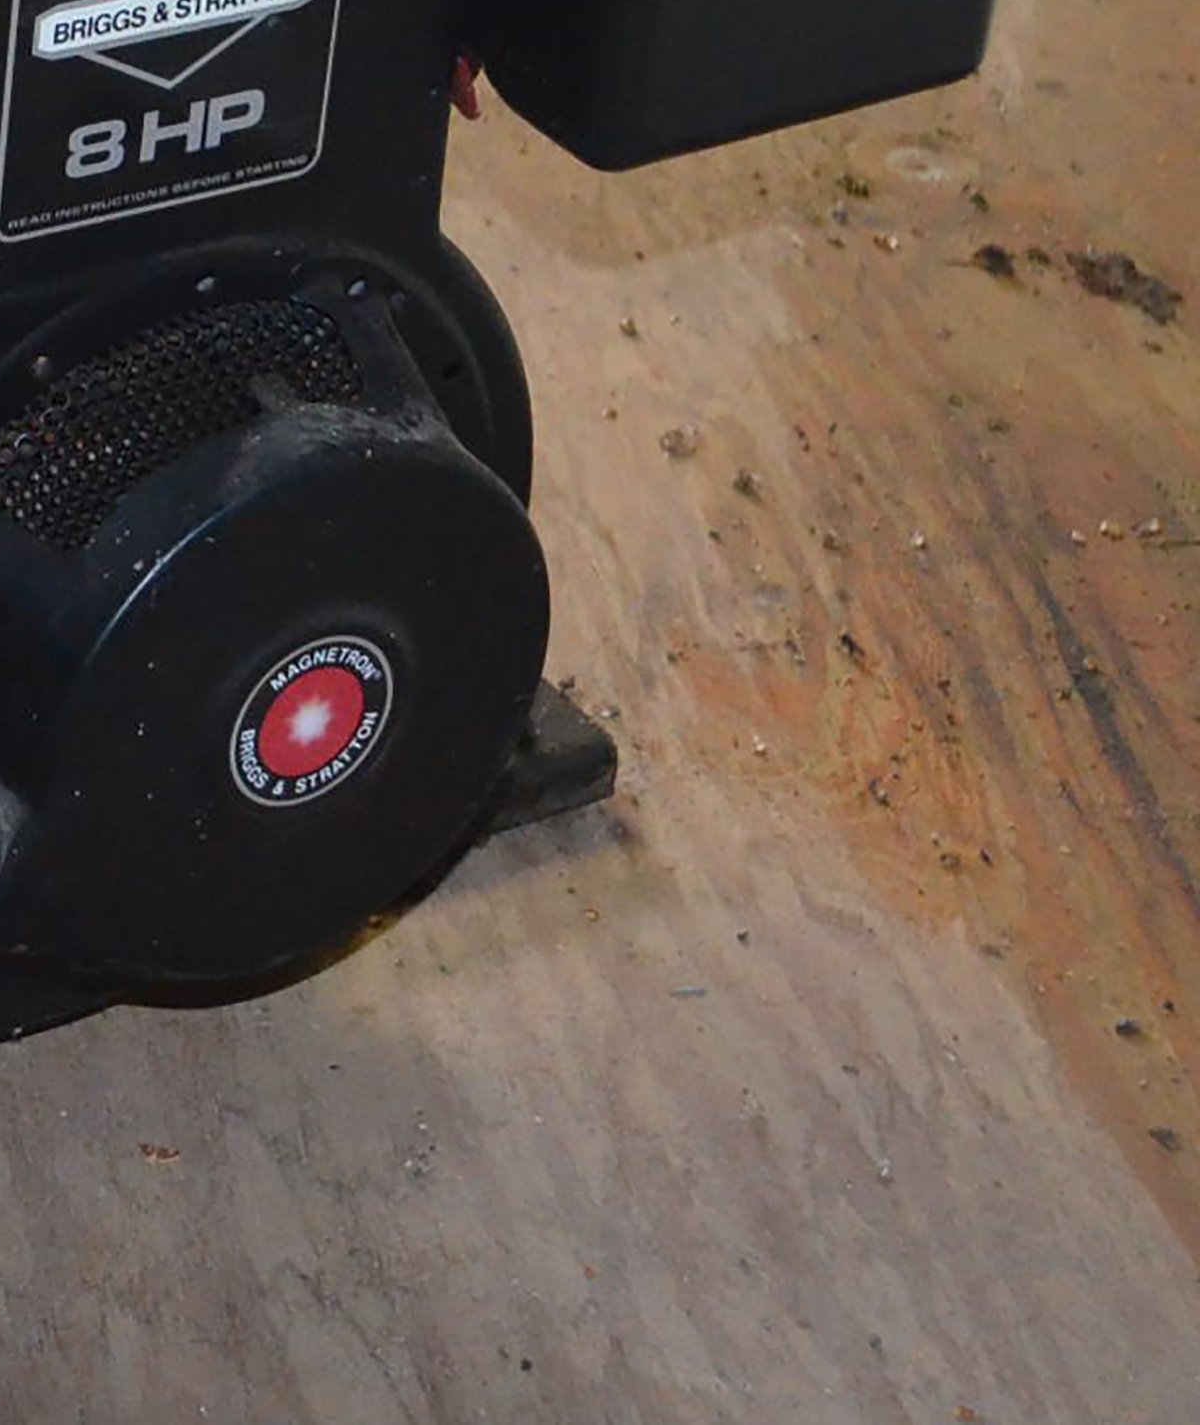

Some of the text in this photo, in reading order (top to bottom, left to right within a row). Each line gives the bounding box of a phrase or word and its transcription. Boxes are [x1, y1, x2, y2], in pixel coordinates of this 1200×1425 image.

[53, 8, 146, 44] BRIGGS
[153, 3, 168, 22] &
[65, 89, 265, 178] 8 HP
[55, 186, 169, 218] INSTRUCTIONS
[172, 171, 231, 193] BEFORE
[235, 155, 308, 178] STARTING
[270, 646, 377, 691] MAGNETRON
[240, 711, 378, 795] BRIGGS & STRATTON
